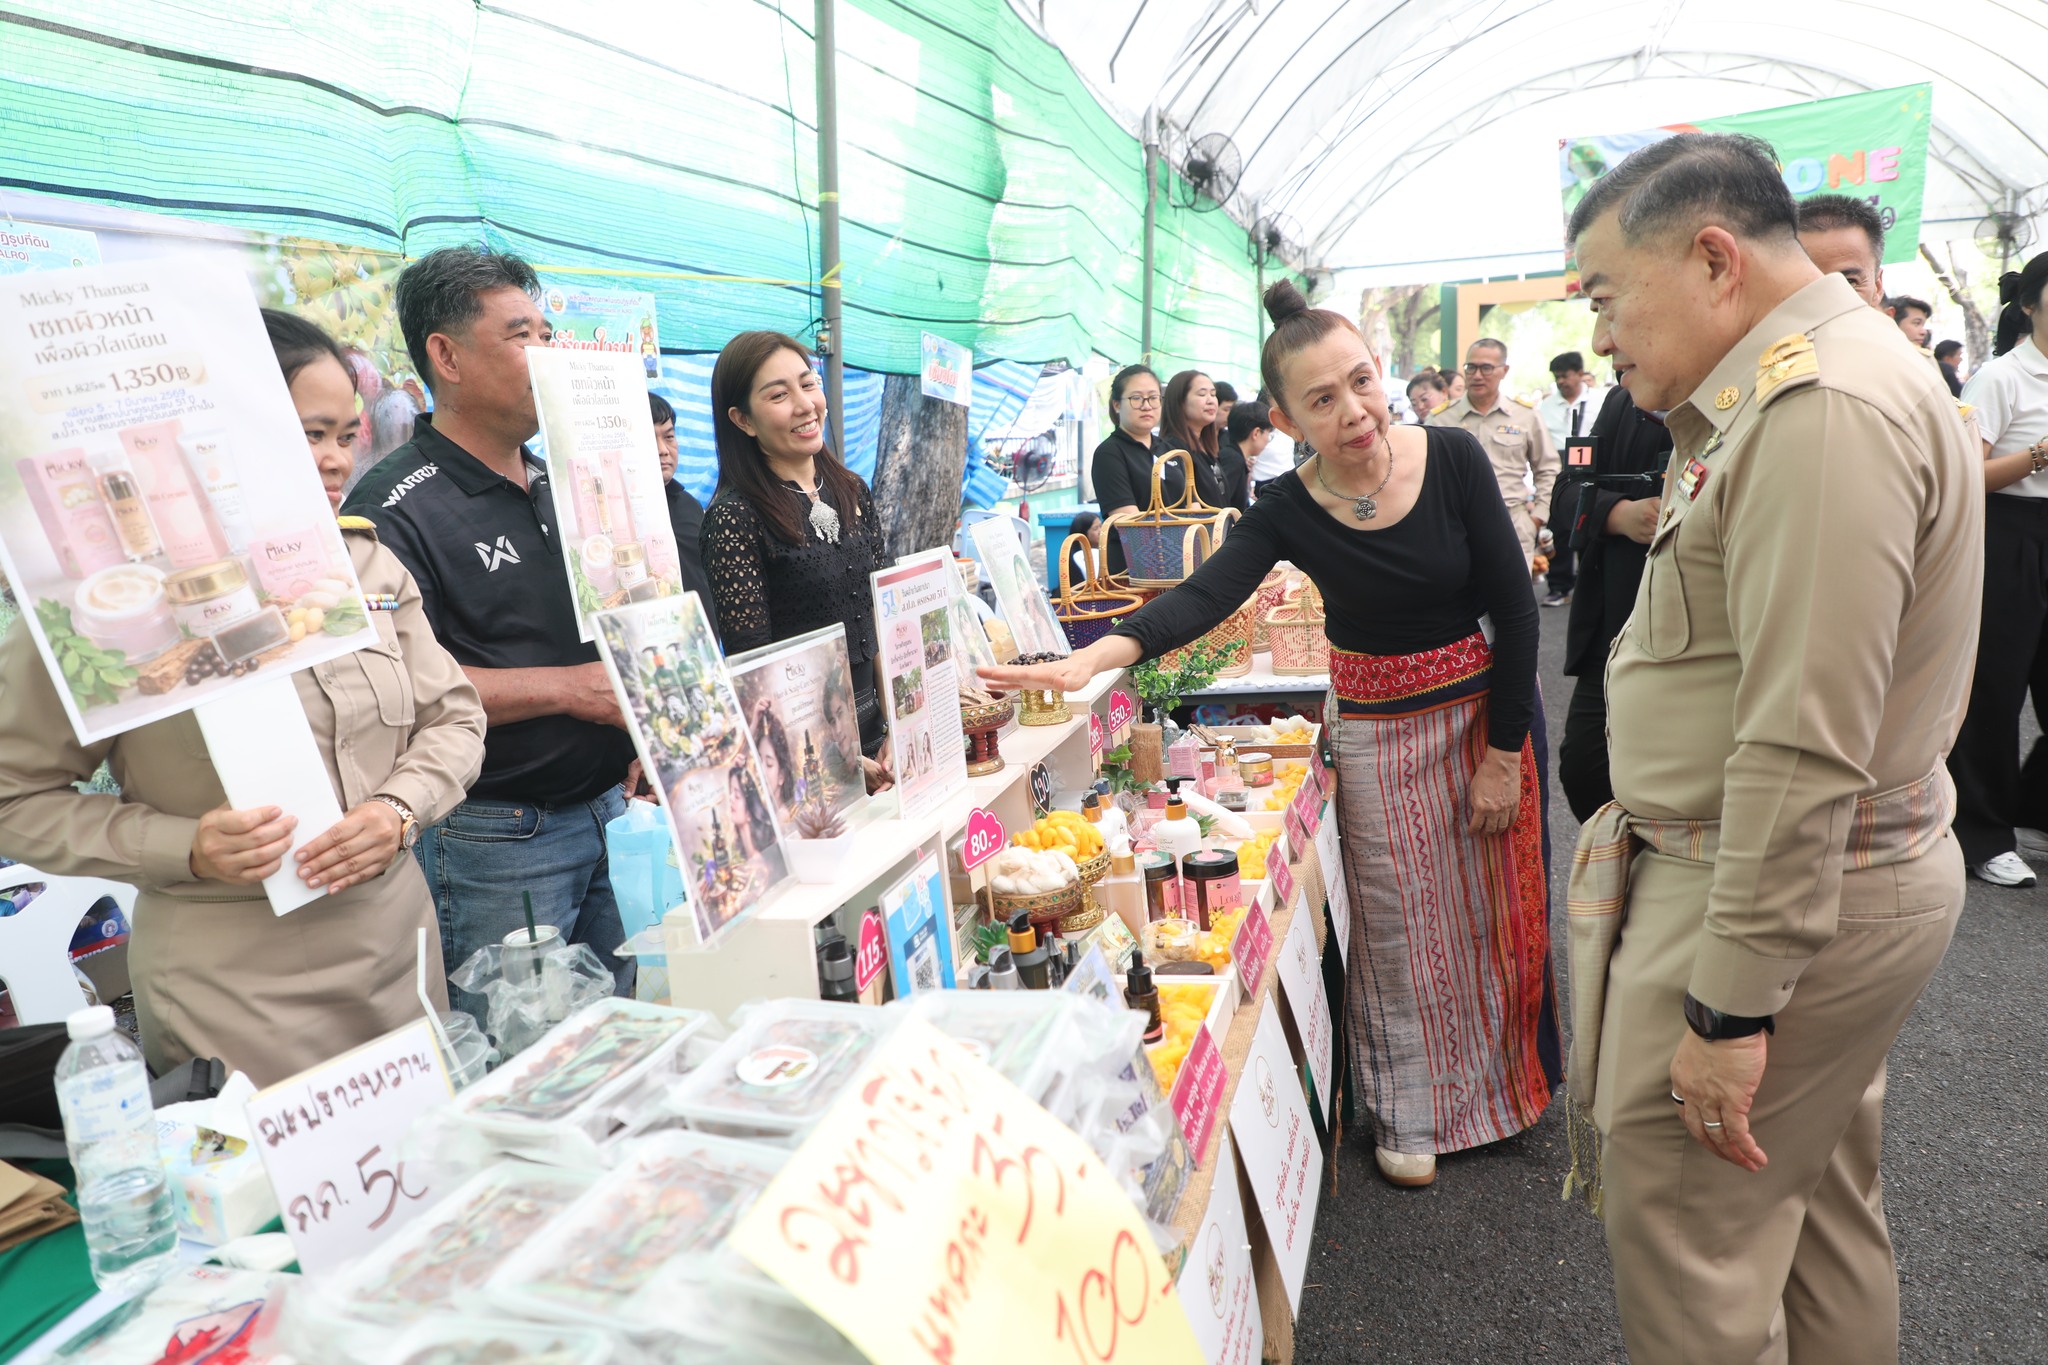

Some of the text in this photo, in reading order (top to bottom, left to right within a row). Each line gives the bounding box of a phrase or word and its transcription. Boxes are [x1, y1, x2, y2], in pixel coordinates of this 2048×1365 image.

[1777, 146, 1902, 195] ONE
[19, 281, 151, 308] Micky Thanaca
[381, 461, 440, 508] WARRIX
[1110, 704, 1131, 728] 550.-
[970, 828, 998, 857] 80.-
